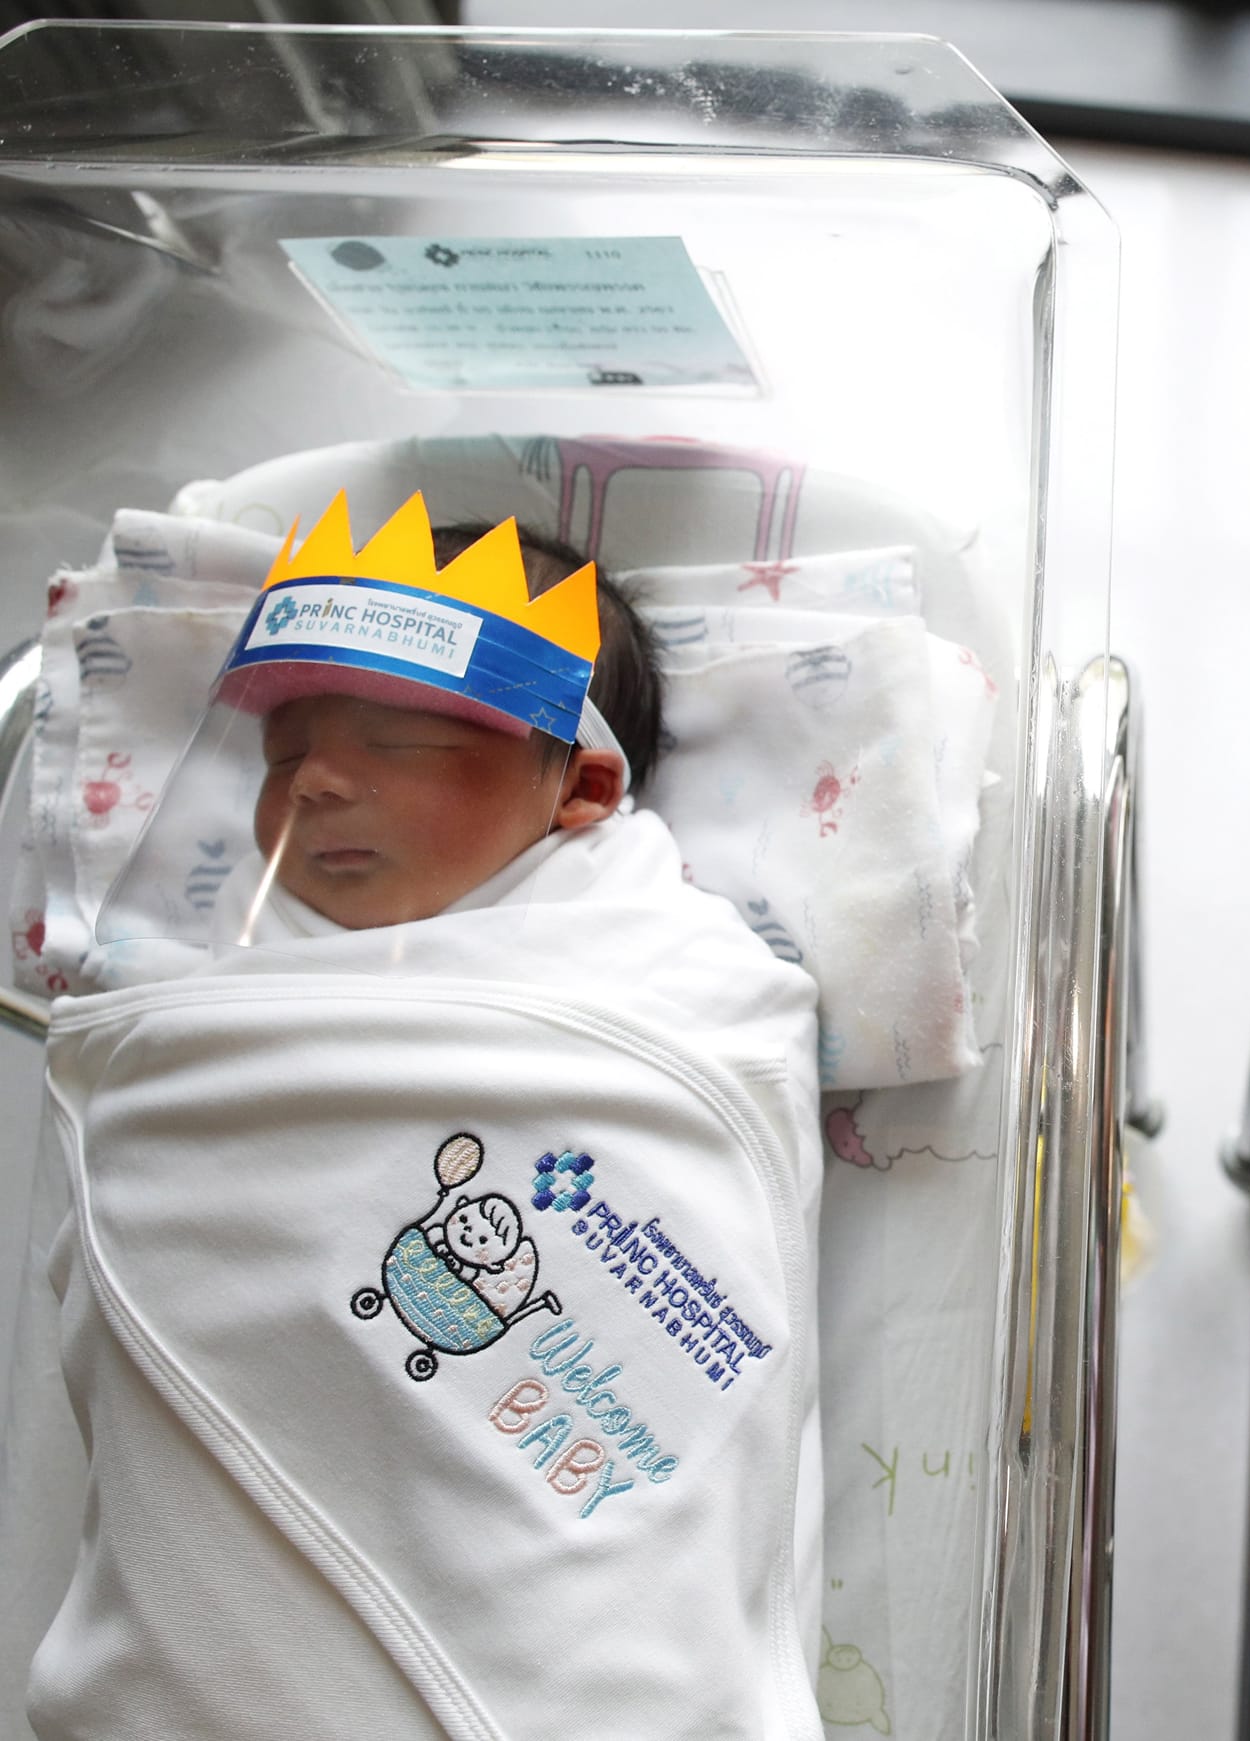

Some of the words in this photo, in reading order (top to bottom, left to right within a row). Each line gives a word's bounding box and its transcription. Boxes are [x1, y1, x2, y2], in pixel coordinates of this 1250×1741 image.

[293, 618, 456, 660] SUVARNABHUMI
[361, 607, 458, 646] HOSPITAL
[571, 1219, 739, 1392] SUVARNABHUMI
[656, 1273, 743, 1376] HOSPITAL
[489, 1378, 635, 1520] BABY
[528, 1317, 680, 1485] Welcome
